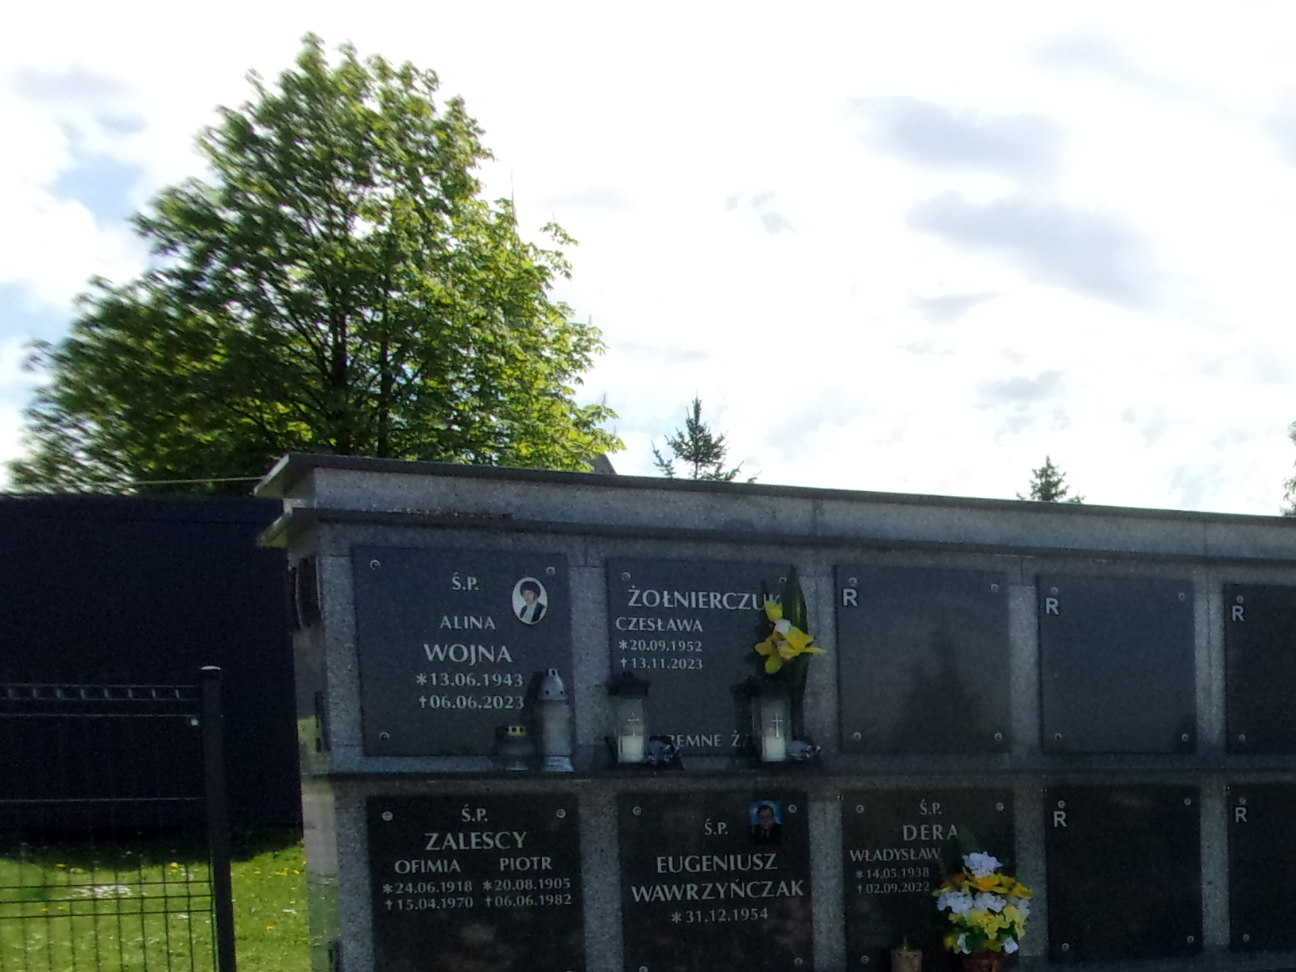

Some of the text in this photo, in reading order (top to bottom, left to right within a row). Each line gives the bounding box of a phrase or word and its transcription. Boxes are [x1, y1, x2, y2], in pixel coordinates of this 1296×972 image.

[451, 571, 480, 591] Ś.P.
[843, 588, 859, 607] R
[1045, 597, 1060, 616] R
[440, 615, 496, 630] ALINA
[1232, 605, 1246, 622] R
[615, 616, 704, 632] CZESŁAWA
[423, 643, 513, 666] WOJNA
[461, 803, 489, 822] Ś.P.
[920, 798, 943, 816] Ś.P.
[1235, 806, 1248, 824] R
[704, 819, 729, 836] Ś.P.
[1053, 810, 1068, 829] R
[424, 831, 527, 851] ZALESCY
[902, 824, 958, 842] DERA
[656, 853, 779, 874] EUGENIUSZ
[850, 848, 941, 863] WŁADYSŁAW
[394, 856, 553, 874] OFIMIA PIOTR
[631, 878, 804, 903] WAWRZYŃCZAK
